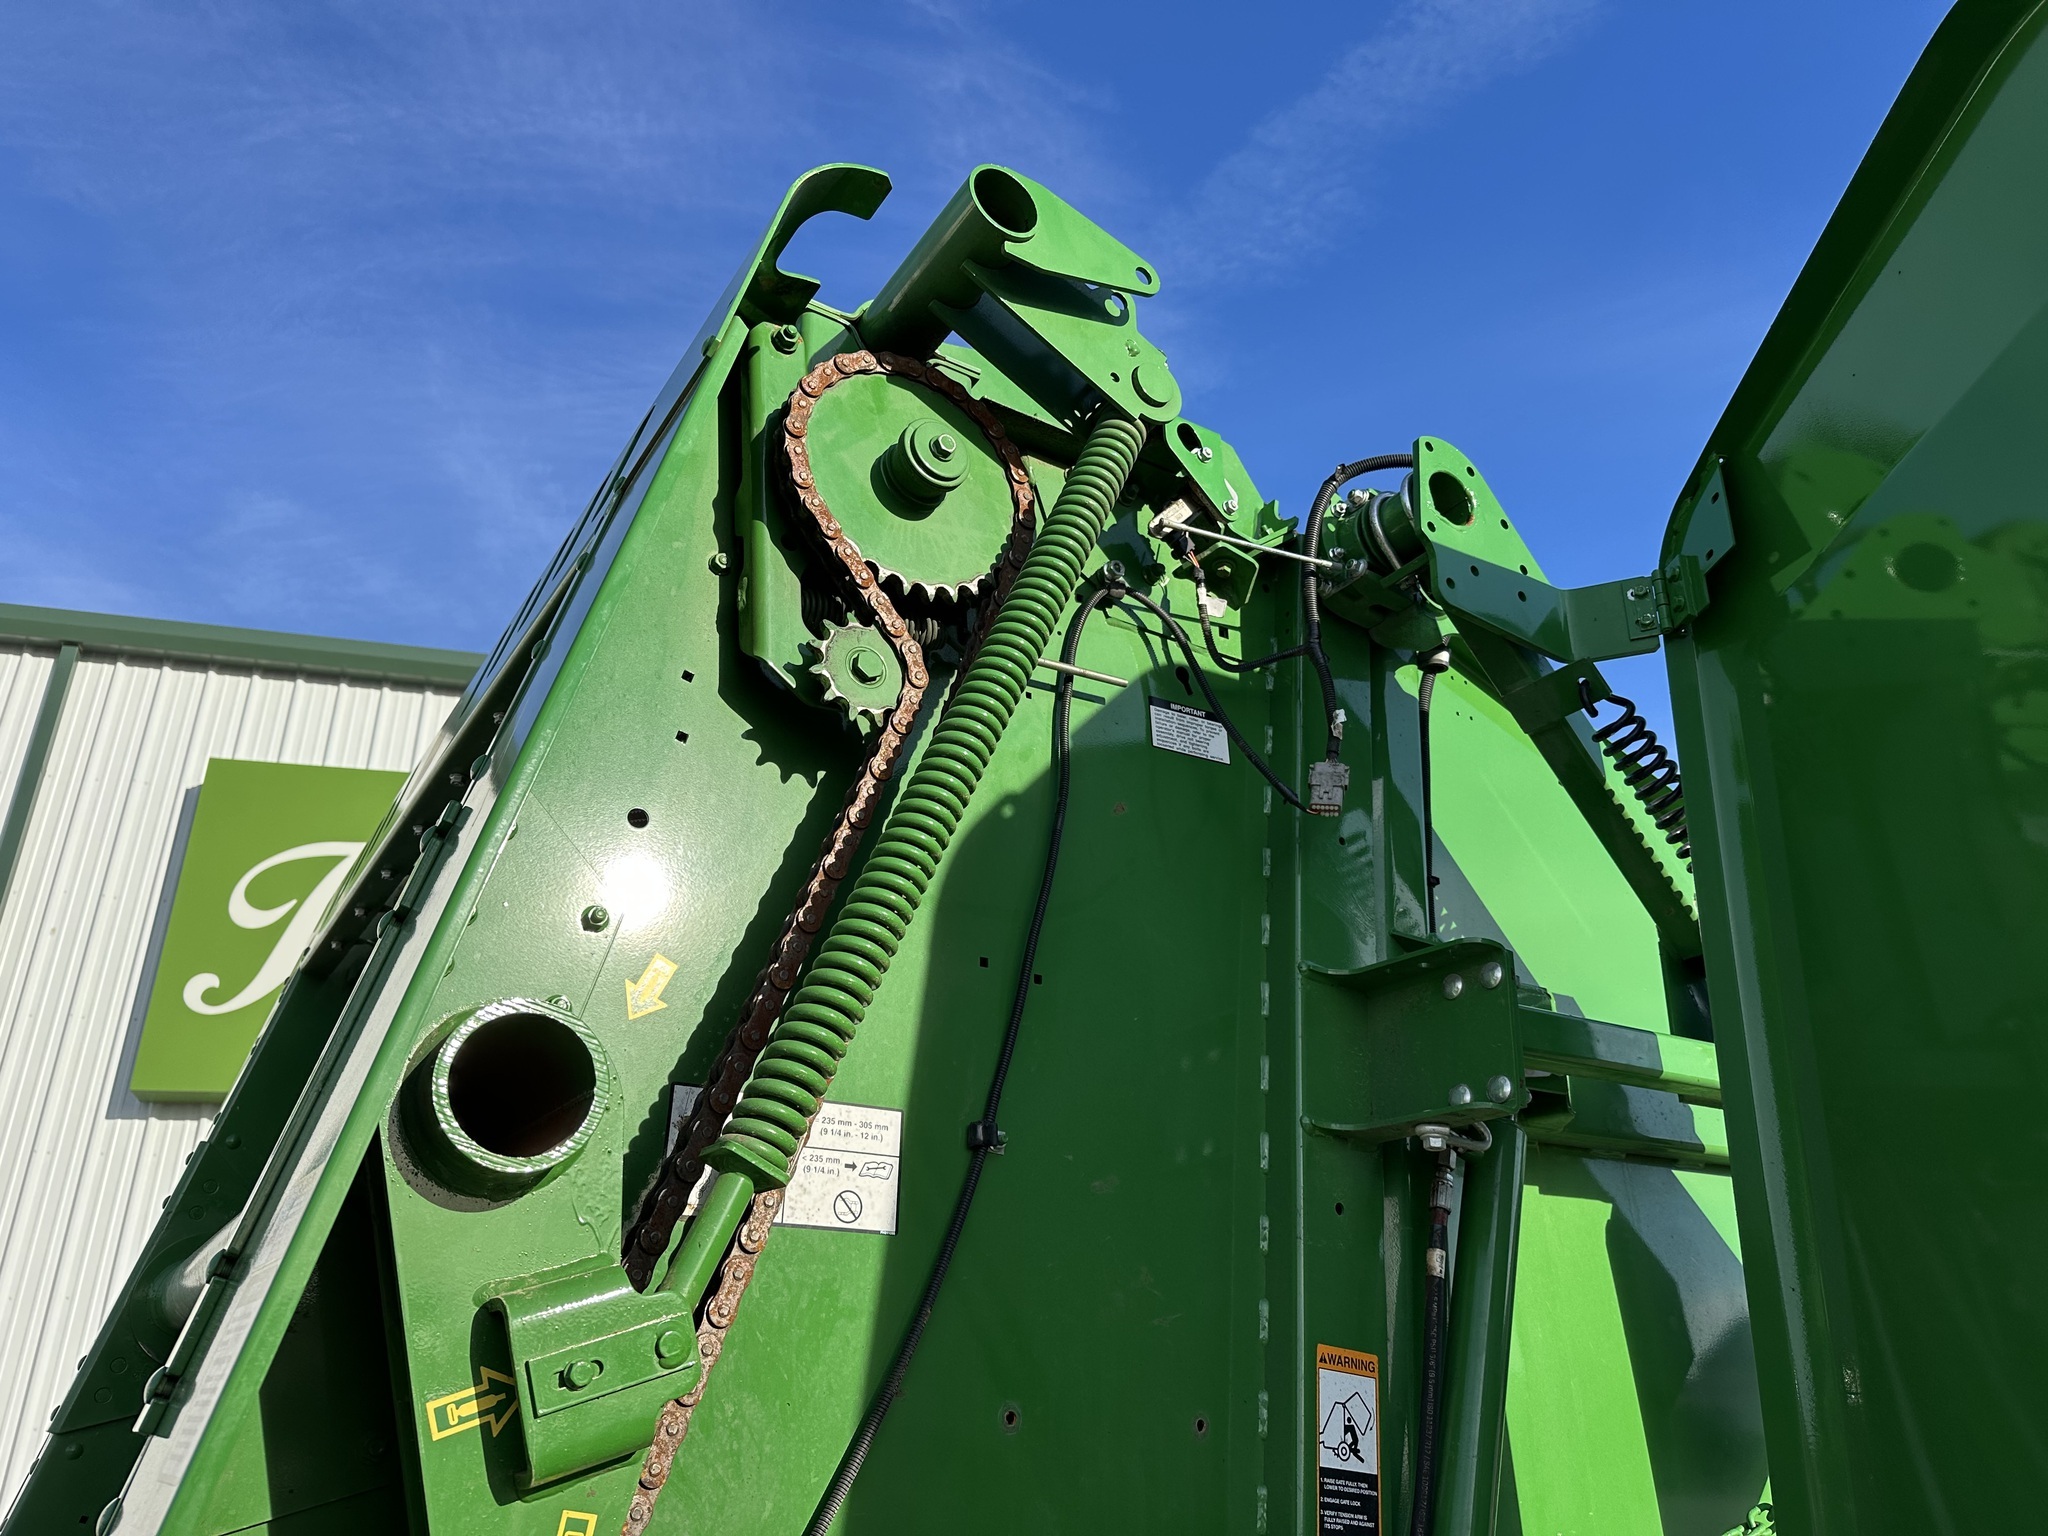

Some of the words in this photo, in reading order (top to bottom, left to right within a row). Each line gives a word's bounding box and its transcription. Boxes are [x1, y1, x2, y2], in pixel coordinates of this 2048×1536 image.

[1170, 703, 1206, 718] IMPORTANT
[822, 1117, 835, 1125] 235
[860, 1121, 872, 1129] 305
[820, 1128, 828, 1136] (9
[871, 1133, 883, 1142] in.)
[803, 1165, 810, 1174] (9
[813, 1166, 825, 1174] 1/4
[827, 1167, 840, 1177] in.)
[1327, 1352, 1375, 1373] WARNING
